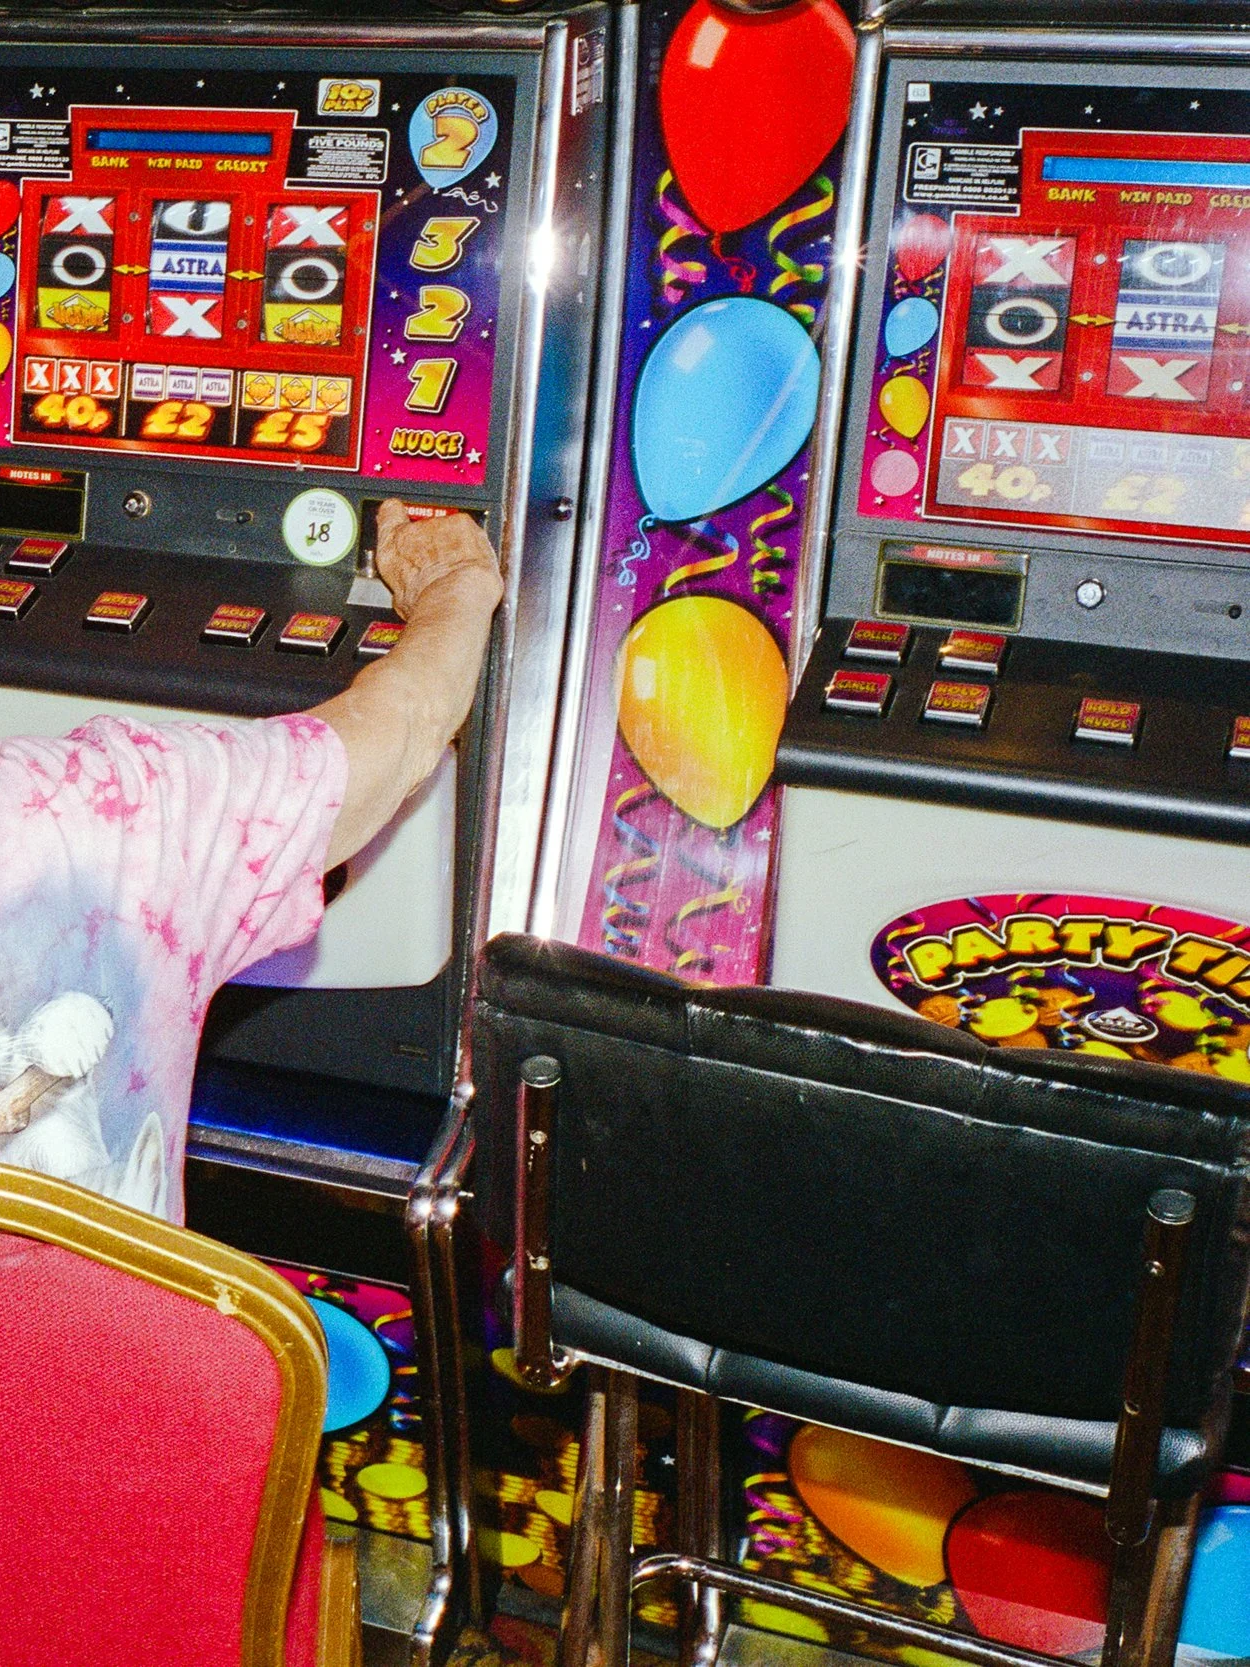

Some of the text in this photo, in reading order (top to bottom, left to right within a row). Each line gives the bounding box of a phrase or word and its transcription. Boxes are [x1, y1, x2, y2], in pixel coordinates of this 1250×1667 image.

[322, 99, 372, 112] PLAY
[426, 88, 489, 121] PLAYER
[309, 138, 384, 149] FIVE POUNDS
[419, 115, 481, 169] 2
[91, 156, 268, 173] BANK WIN PAID CREDIT
[913, 184, 961, 192] FREEPHONE
[1048, 188, 1097, 202] BANK
[1120, 190, 1150, 204] WIN
[1156, 192, 1193, 206] PAID
[409, 216, 481, 272] 3
[162, 256, 223, 276] ASTRA
[403, 285, 471, 342] 2
[1125, 310, 1209, 333] ASTRA
[138, 377, 226, 393] ASTRA ASTRA ASTRA
[404, 357, 457, 412] 1
[34, 394, 111, 433] 40p
[141, 401, 215, 440] £2
[251, 410, 331, 449] £5
[390, 428, 464, 458] NUDGE
[10, 469, 51, 481] NOTES IN
[957, 463, 1052, 501] 40p
[316, 500, 336, 508] YEARS
[434, 509, 447, 517] IN
[308, 521, 331, 543] 18
[926, 548, 981, 562] NOTES IN
[855, 630, 900, 642] COLLECT
[937, 685, 980, 696] HOLD
[1086, 702, 1132, 715] HOLD
[906, 918, 1250, 1000] PARTY TI
